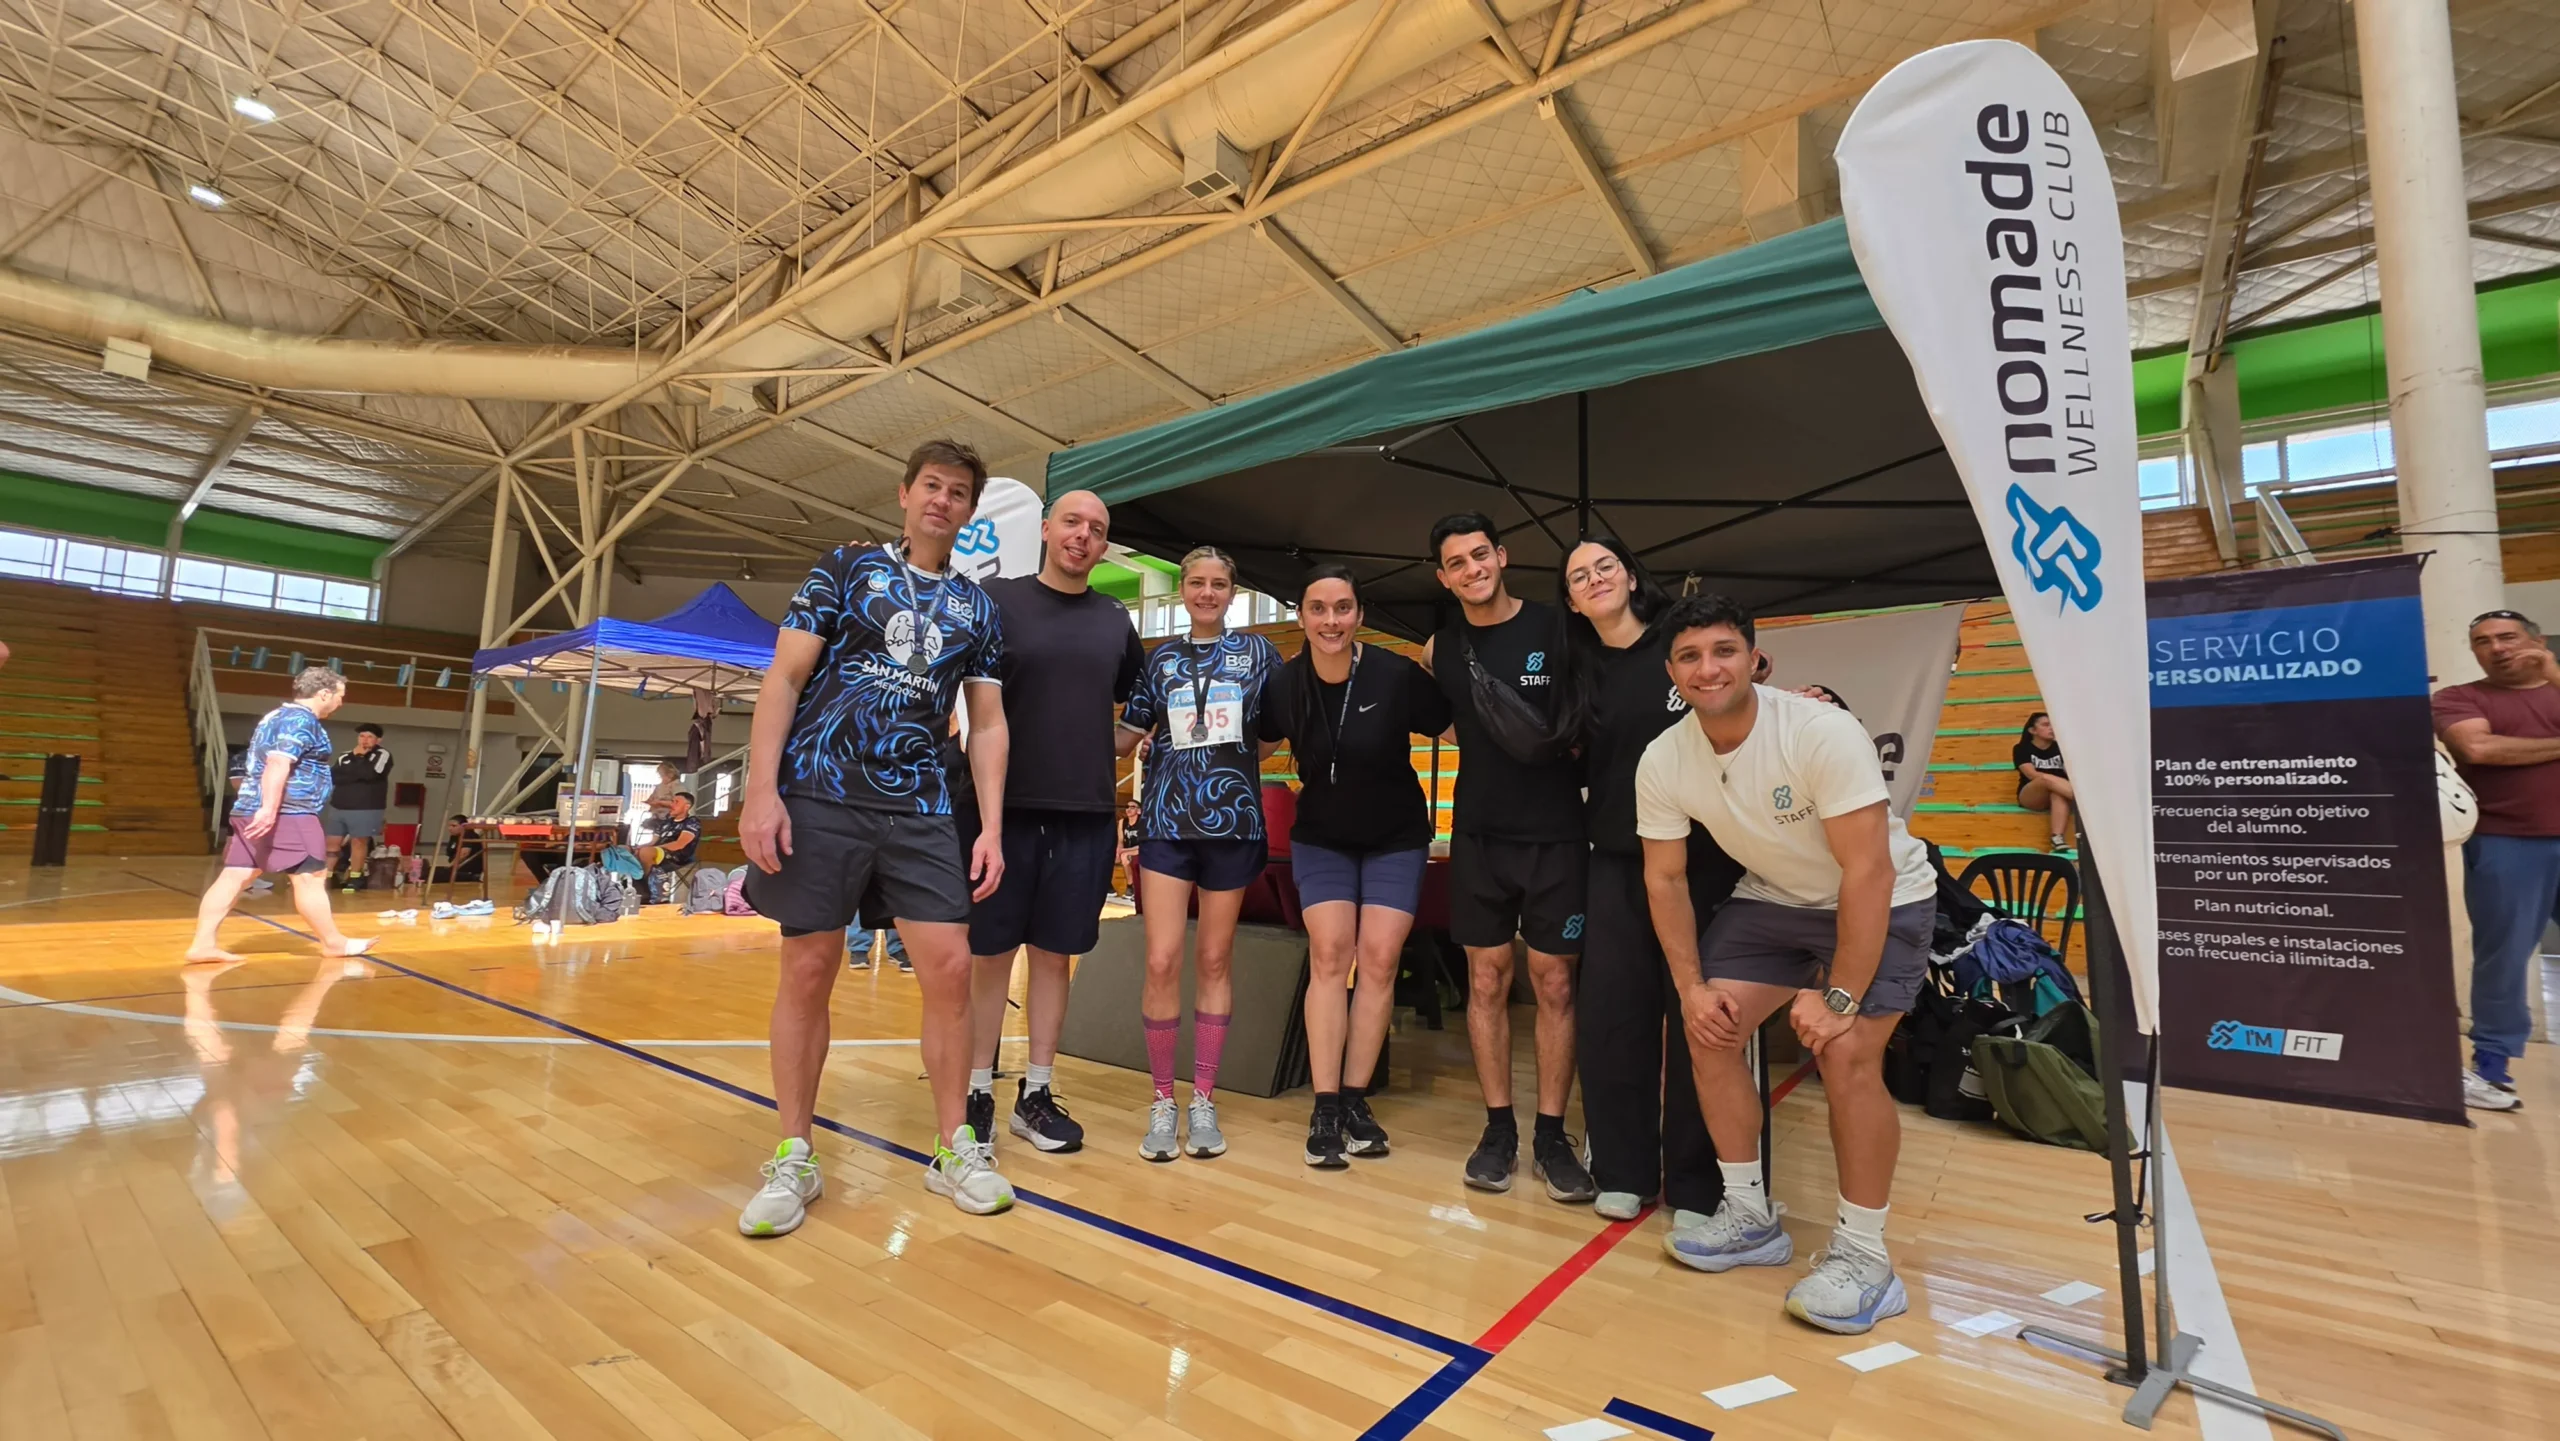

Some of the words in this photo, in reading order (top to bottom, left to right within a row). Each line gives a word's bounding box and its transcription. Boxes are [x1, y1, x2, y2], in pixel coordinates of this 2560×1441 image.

[2044, 111, 2075, 221] CLUB
[1965, 104, 2056, 473] nomade
[2053, 240, 2097, 476] WELLNESS
[2155, 627, 2340, 663] SERVICIO
[862, 660, 891, 678] SAN
[873, 679, 922, 701] MENDOZA
[1520, 675, 1551, 686] STAFF
[2155, 758, 2192, 771] Plan
[2195, 758, 2217, 771] de
[2220, 756, 2358, 770] entrenamiento
[2164, 774, 2211, 787] 100%
[2214, 772, 2349, 789] personalizado.
[1774, 805, 1815, 825] STAFF
[2152, 804, 2238, 818] Frecuencia
[2241, 804, 2293, 821] según
[2296, 804, 2370, 821] objetivo
[2207, 821, 2233, 834] del
[2236, 821, 2308, 835] alumno.
[2153, 852, 2269, 867] ntrenamientos
[2272, 854, 2392, 870] supervisados
[2194, 870, 2223, 883] por
[2226, 870, 2249, 882] un
[2252, 869, 2329, 885] profesor.
[2194, 899, 2231, 913] Plan
[2234, 901, 2335, 918] nutricional.
[2157, 930, 2191, 942] ases
[2194, 932, 2266, 948] grupales
[2269, 936, 2280, 947] e
[2283, 934, 2404, 955] instalaciones
[2166, 945, 2194, 957] con
[2198, 946, 2286, 964] frecuencia
[2289, 950, 2376, 970] ilimitada.
[2245, 1029, 2273, 1048] I'M
[2293, 1034, 2328, 1053] FIT
